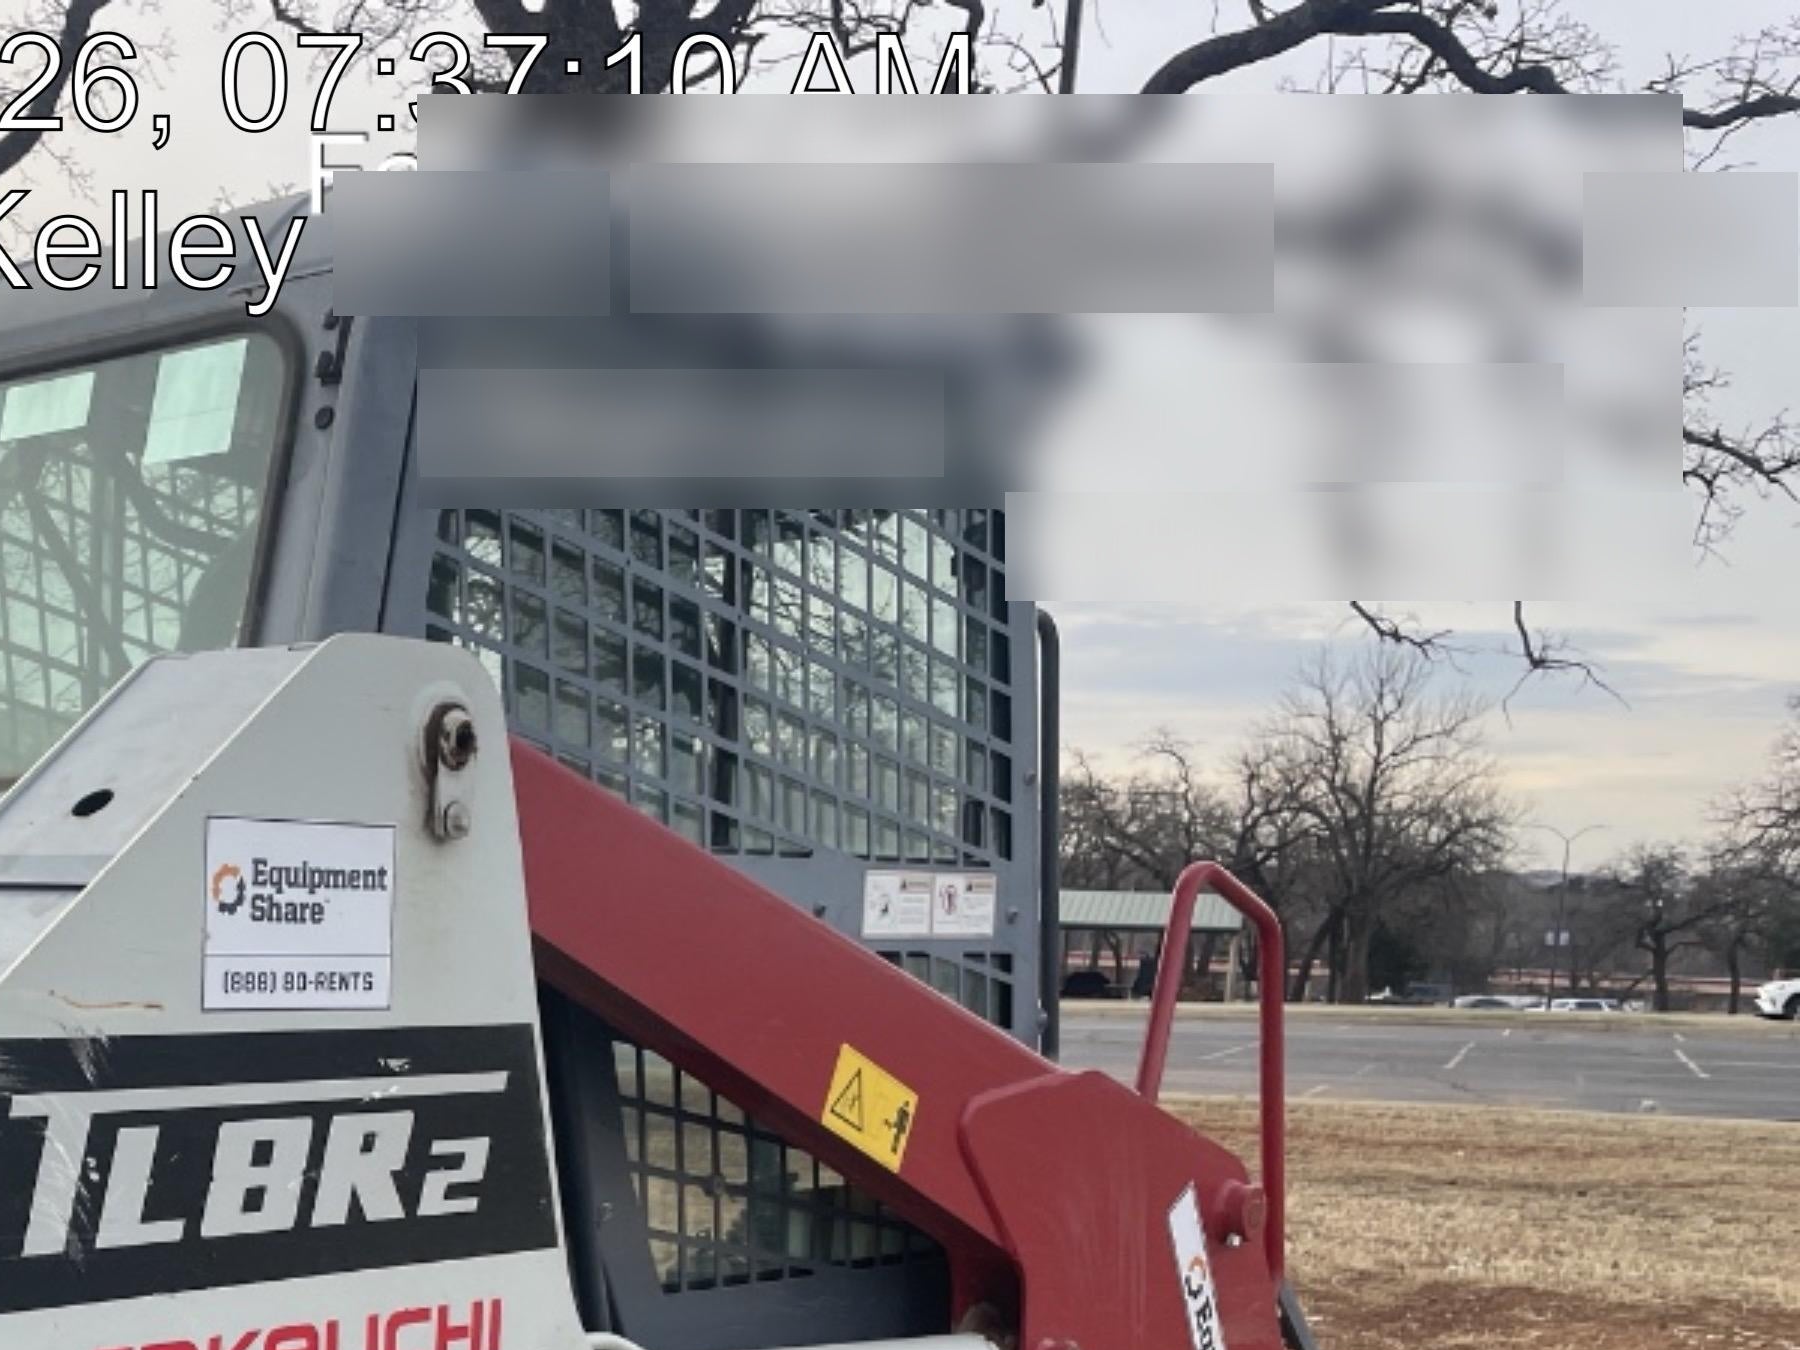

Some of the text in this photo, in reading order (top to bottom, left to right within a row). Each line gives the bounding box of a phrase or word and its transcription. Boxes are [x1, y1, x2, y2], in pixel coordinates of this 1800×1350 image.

[251, 857, 388, 895] Equipment
[250, 893, 325, 925] Share
[223, 970, 277, 994] (888)
